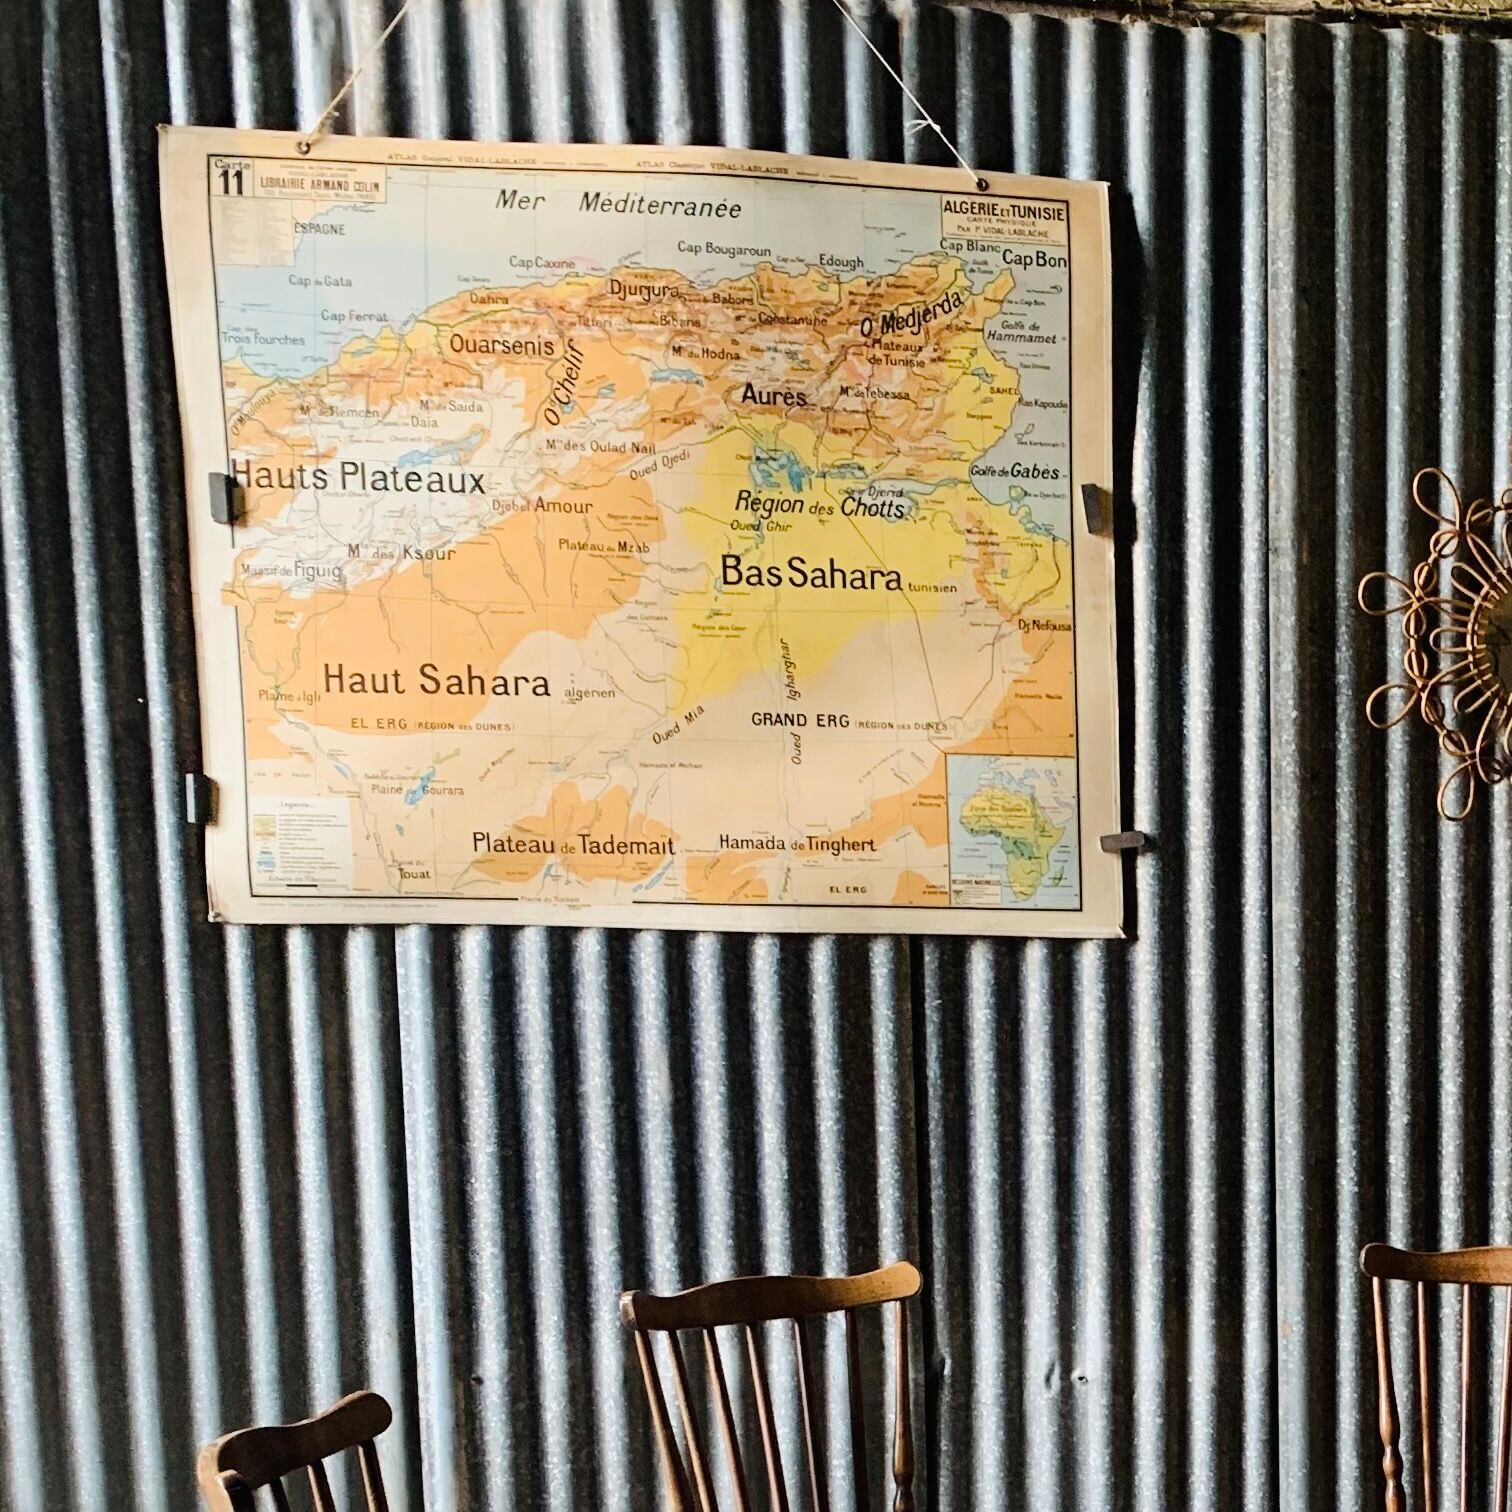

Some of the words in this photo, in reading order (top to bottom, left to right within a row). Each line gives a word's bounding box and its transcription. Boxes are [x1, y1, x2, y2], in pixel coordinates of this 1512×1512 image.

[214, 158, 250, 170] Carte
[218, 169, 243, 196] 11
[260, 176, 304, 190] LIBRAIRIE
[310, 179, 349, 192] ARMAND
[495, 188, 547, 211] Mer
[578, 190, 743, 219] Méditerranée
[1010, 204, 1065, 222] TUNISIE
[294, 222, 347, 236] ESPAGNE
[678, 240, 702, 257] Cap
[706, 241, 772, 259] Bougaroun
[939, 238, 964, 255] Cap
[967, 239, 1001, 253] Blanc
[509, 254, 534, 270] Cap
[534, 256, 577, 270] Caxine
[818, 253, 865, 271] Edough
[1002, 248, 1033, 270] Cap
[1036, 250, 1068, 269] Bon
[289, 273, 312, 289] Cap
[324, 274, 353, 288] Gata
[469, 291, 510, 306] Dahra
[610, 279, 680, 302] Djurjura
[712, 291, 755, 306] Babors
[320, 307, 347, 323] Cap
[349, 309, 389, 323] Ferrat
[879, 289, 963, 336] Medjerda
[221, 331, 250, 345] Trois
[253, 330, 306, 346] Fourches
[449, 332, 555, 357] Ouarsenis
[986, 329, 1058, 345] Hammamet
[702, 346, 742, 361] Hodna
[885, 353, 926, 369] Tunisie
[552, 338, 585, 407] Chélif
[740, 381, 810, 408] Aurès
[989, 385, 1019, 396] SAHEL
[564, 440, 587, 452] des
[590, 439, 627, 454] Oulad
[629, 460, 659, 481] Oued
[662, 448, 691, 470] Djedi
[970, 463, 997, 479] Golfe
[1010, 461, 1061, 481] Gabès
[231, 457, 329, 491] Hauts
[340, 459, 487, 495] Plateaux
[533, 495, 594, 516] Amour
[734, 489, 805, 520] Région
[809, 500, 835, 516] des
[840, 496, 906, 519] Chotts
[730, 519, 760, 532] Oued
[373, 549, 395, 560] des
[403, 544, 457, 561] Ksour
[558, 538, 605, 552] Plateau
[617, 541, 651, 554] Mzab
[293, 559, 343, 582] Figuig
[721, 553, 784, 588] Bas
[787, 555, 903, 592] Sahara
[908, 582, 958, 594] tunisien
[323, 662, 406, 695] Haut
[418, 662, 552, 698] Sahara
[564, 686, 616, 700] algérien
[351, 717, 369, 729] EL
[376, 717, 409, 730] ERG
[751, 711, 808, 728] GRAND
[816, 713, 851, 728] ERG
[652, 721, 682, 746] Oued
[790, 731, 802, 766] Oued
[472, 831, 556, 854] Plateau
[560, 842, 576, 854] de
[719, 833, 786, 851] Hamada
[805, 835, 877, 857] Tinghert
[398, 866, 431, 880] Touat
[829, 885, 841, 894] EL
[846, 885, 868, 894] ERG
